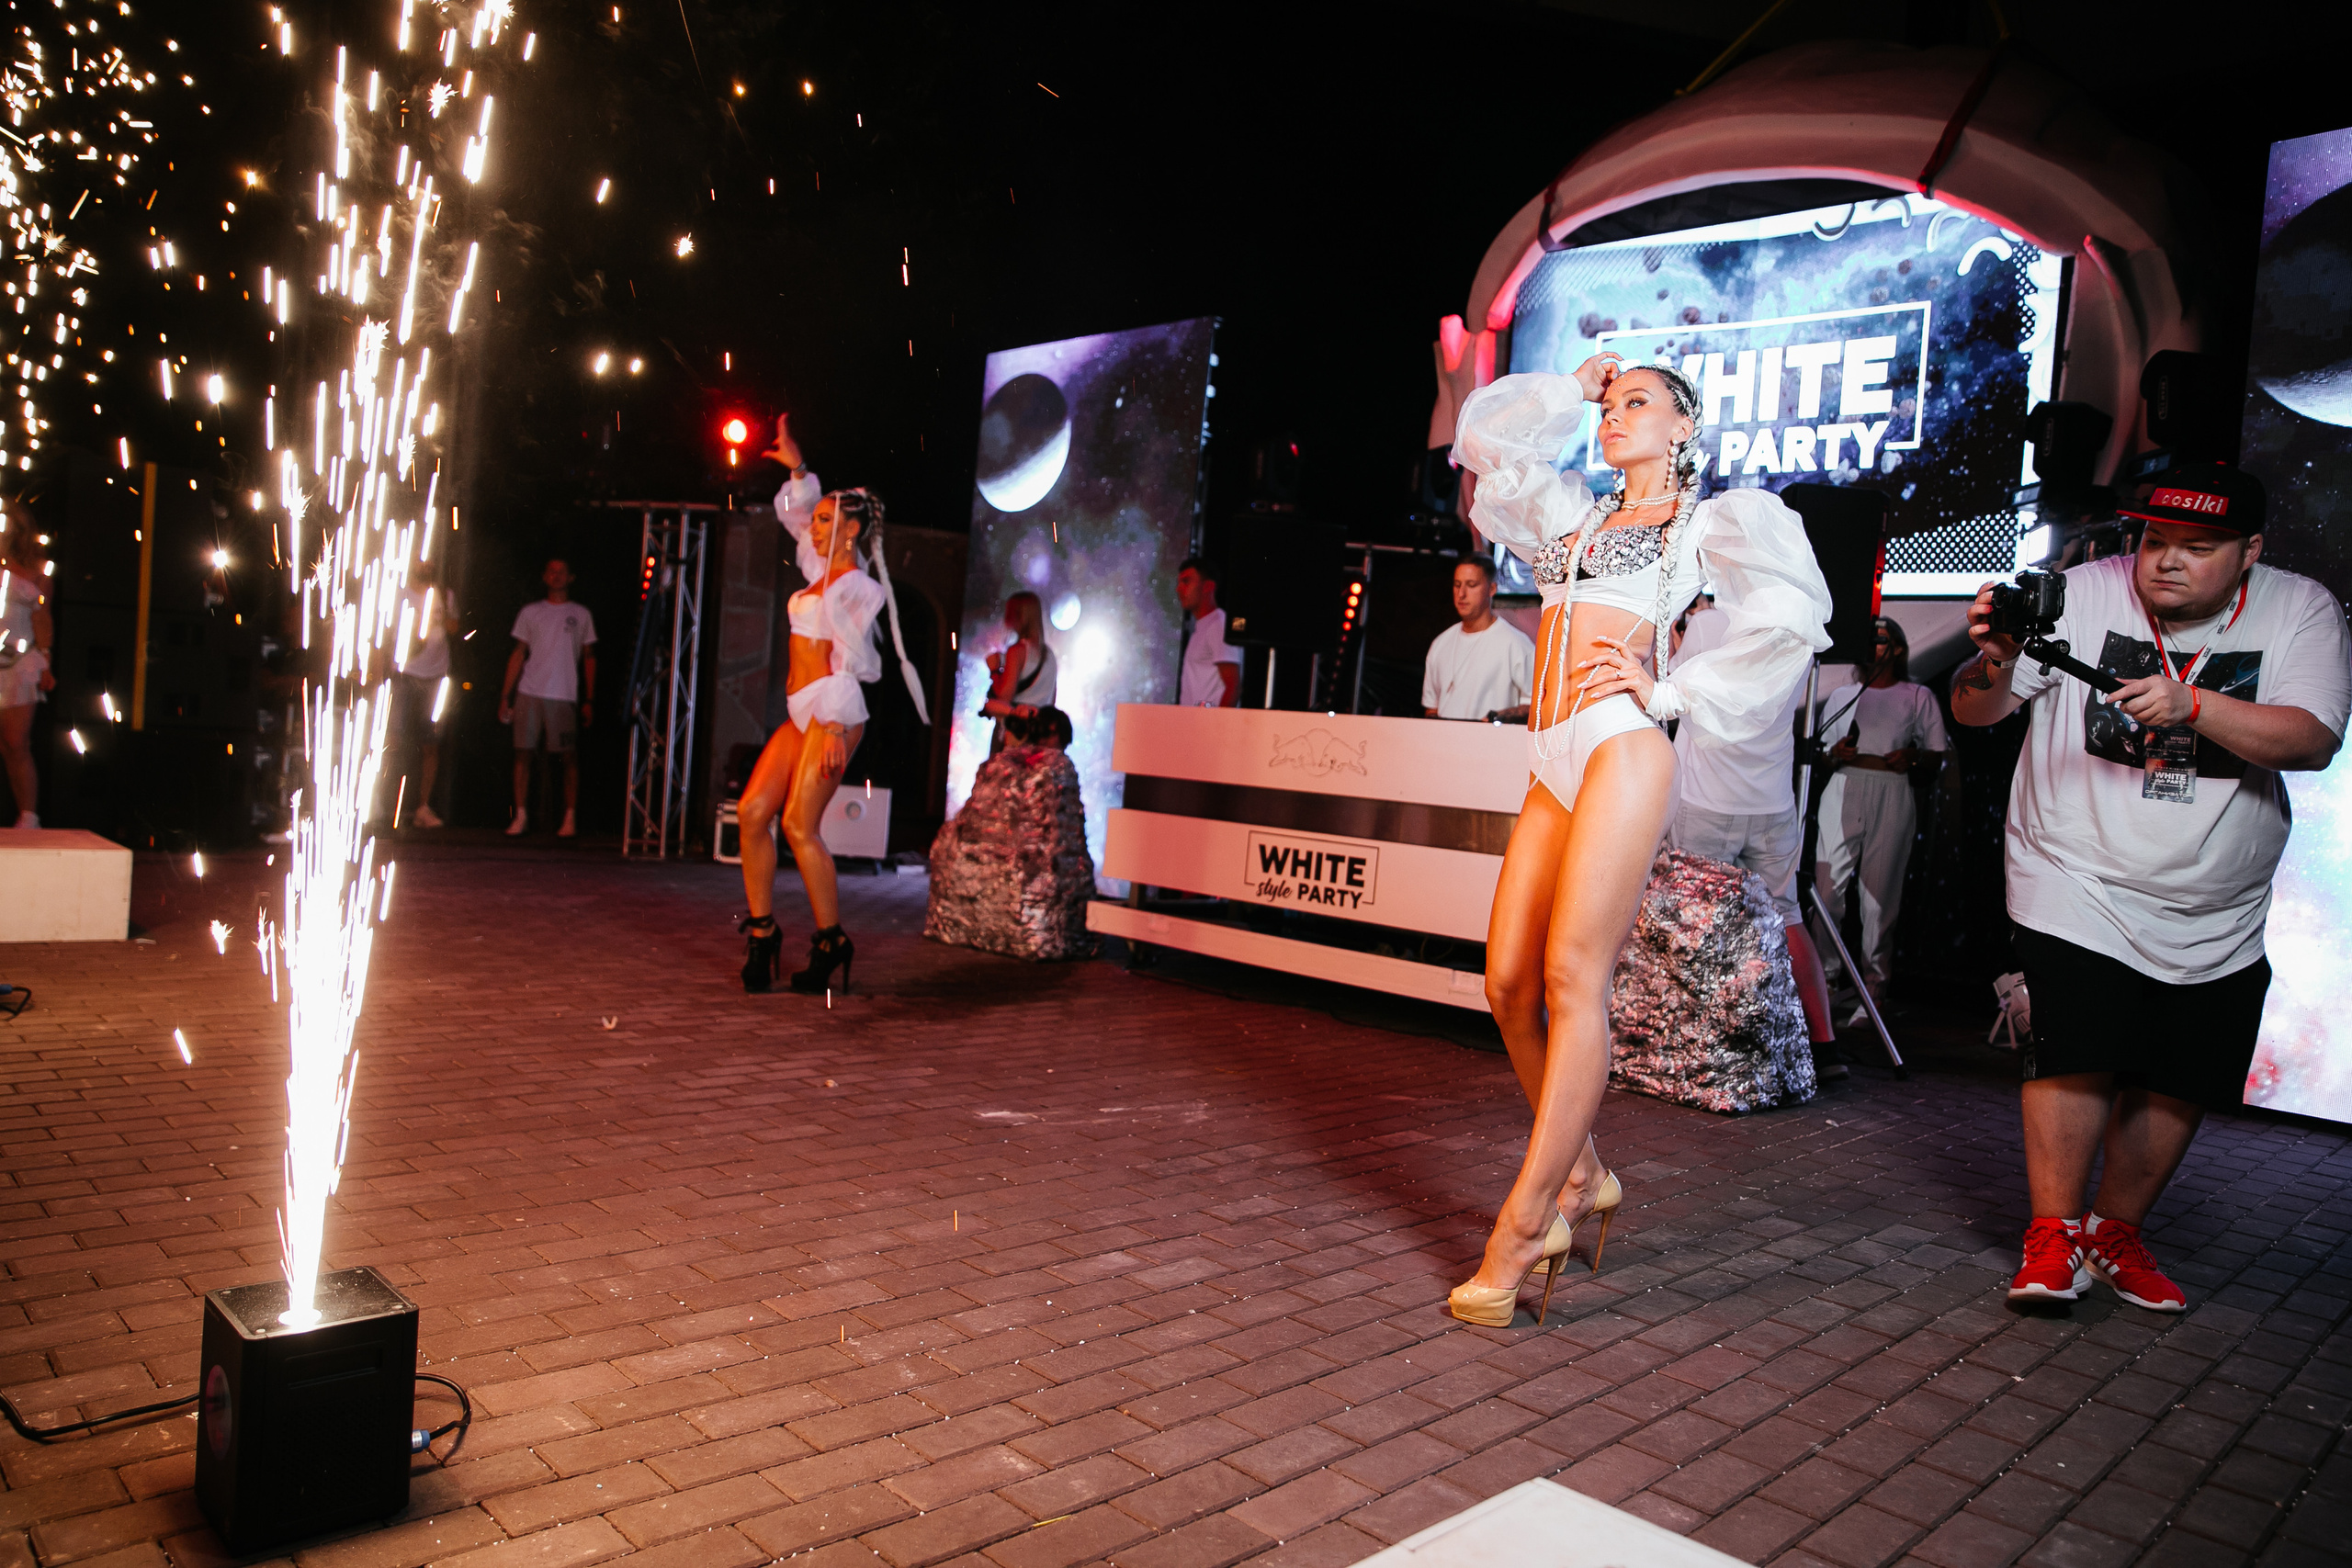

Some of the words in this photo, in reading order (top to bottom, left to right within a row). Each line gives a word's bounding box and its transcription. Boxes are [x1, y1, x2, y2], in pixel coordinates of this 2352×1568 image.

[1718, 421, 1890, 477] PARTY
[2154, 772, 2187, 781] WHITE
[1259, 843, 1366, 887] WHITE
[1256, 877, 1293, 902] style
[1297, 883, 1363, 909] PARTY
